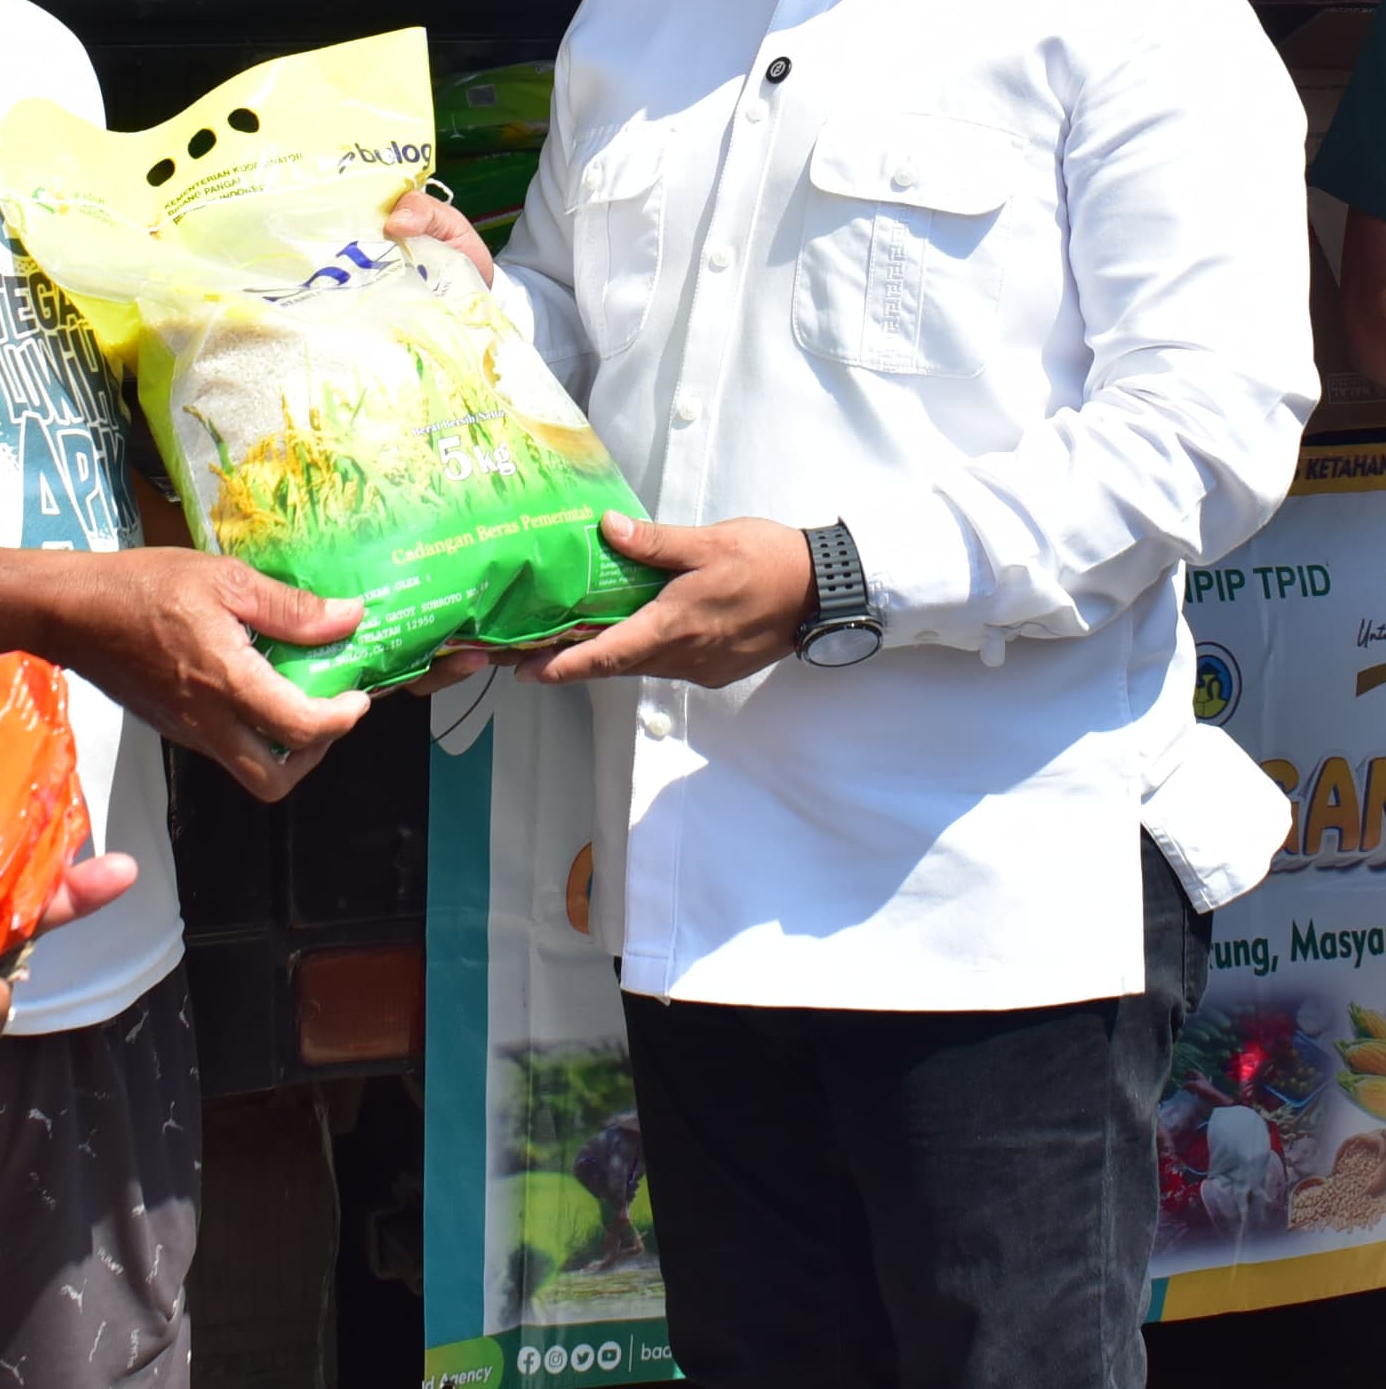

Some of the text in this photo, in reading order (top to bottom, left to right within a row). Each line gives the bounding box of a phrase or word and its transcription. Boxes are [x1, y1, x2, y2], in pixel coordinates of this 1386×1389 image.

[354, 141, 433, 171] bulog
[437, 435, 517, 481] 5 kg
[391, 504, 595, 565] Cadangan Beras Pemerintah
[1252, 564, 1332, 600] TPID
[385, 606, 416, 623] GATOT
[420, 592, 463, 613] SUBROTO
[357, 625, 401, 644] SELATAN
[1207, 936, 1279, 976] ung,
